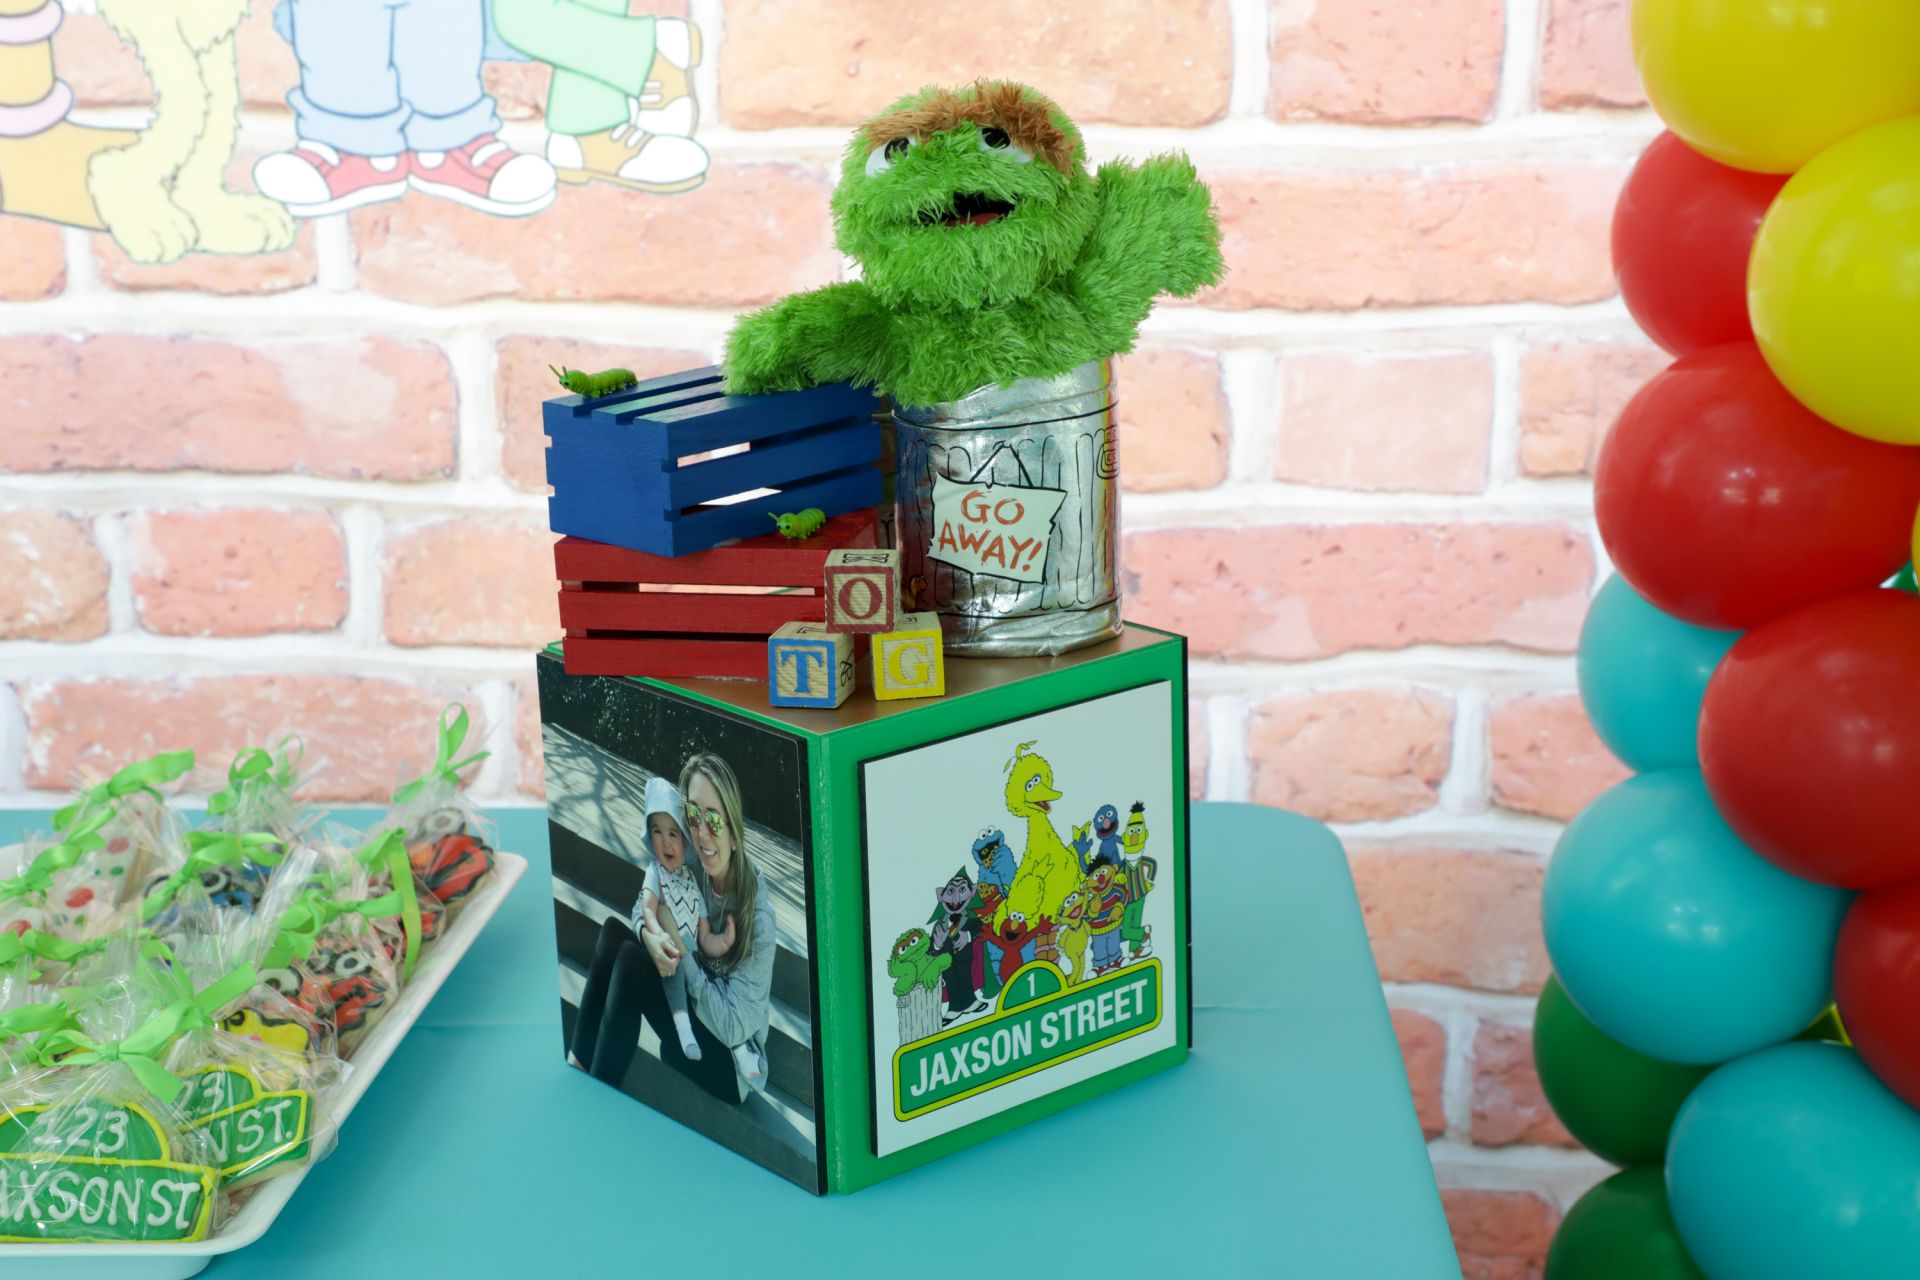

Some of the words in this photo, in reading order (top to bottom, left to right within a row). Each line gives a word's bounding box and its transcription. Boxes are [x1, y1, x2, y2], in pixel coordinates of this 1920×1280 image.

[961, 490, 1025, 525] GO
[938, 519, 1043, 572] AWAY!
[838, 577, 882, 620] O
[781, 651, 823, 693] T
[888, 642, 930, 685] G
[1027, 973, 1036, 997] 1
[910, 1021, 1032, 1097] JAXSON
[1040, 979, 1148, 1049] STREET
[33, 1107, 130, 1154] 123
